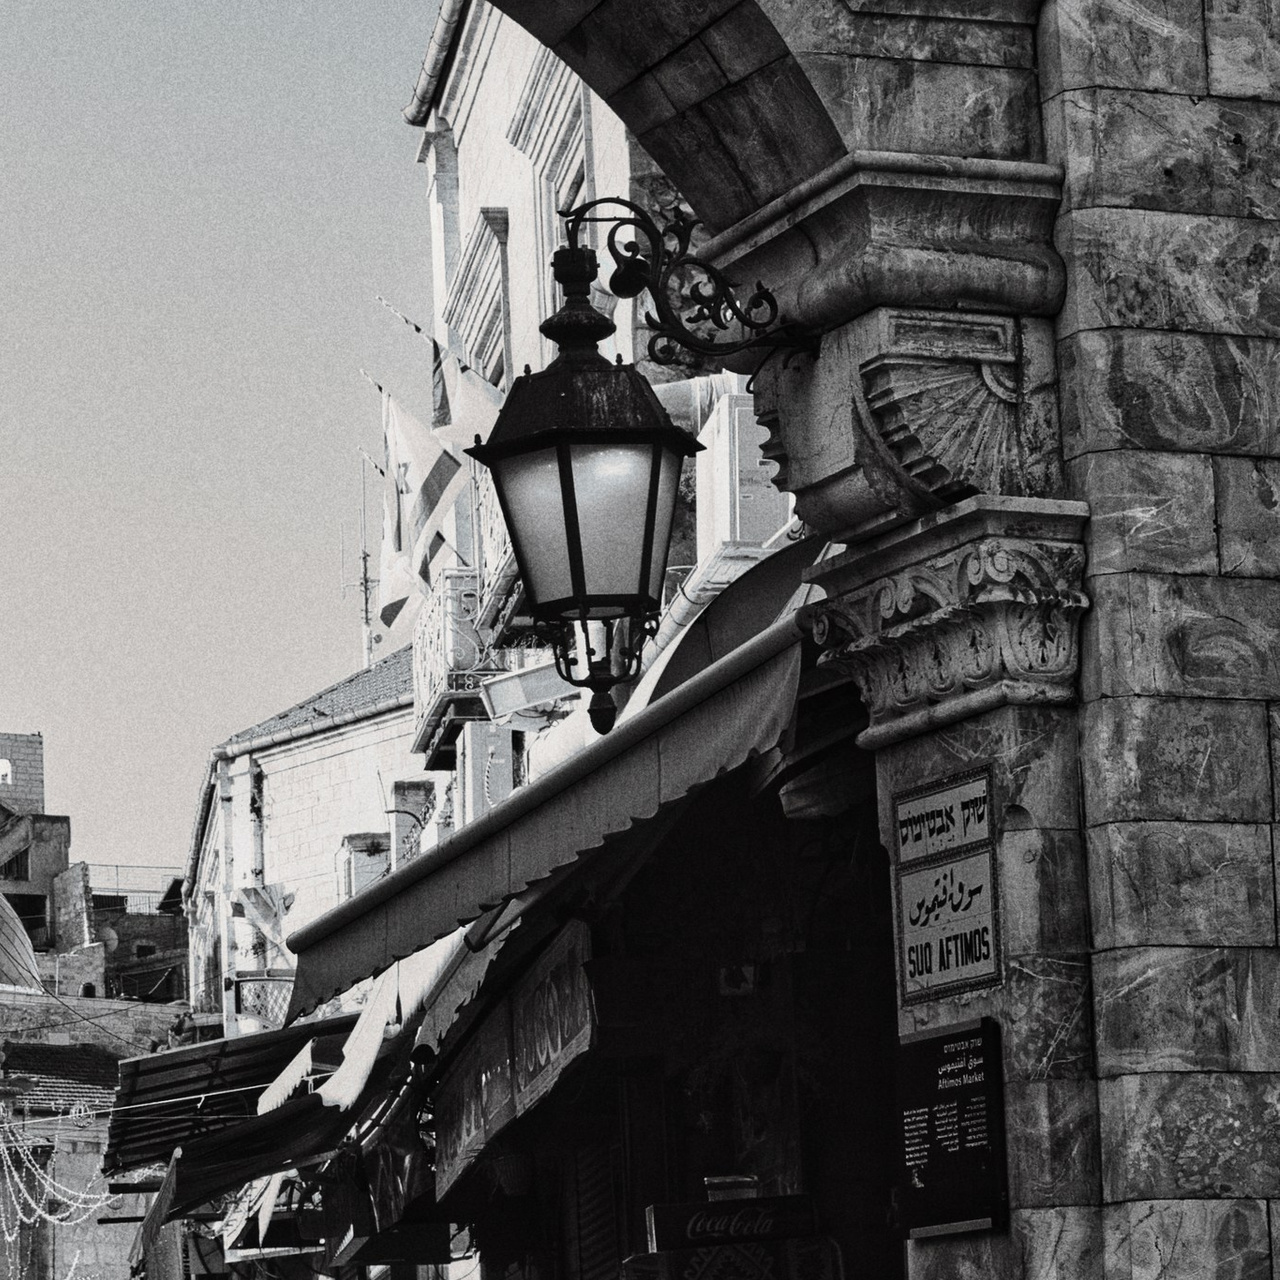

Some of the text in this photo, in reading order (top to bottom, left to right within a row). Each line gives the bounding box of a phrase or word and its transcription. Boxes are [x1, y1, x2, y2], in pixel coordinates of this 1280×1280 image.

[908, 926, 990, 978] SUQ AFTIMOS
[967, 1054, 984, 1070] سوق
[937, 1071, 985, 1090] Aftimos Market
